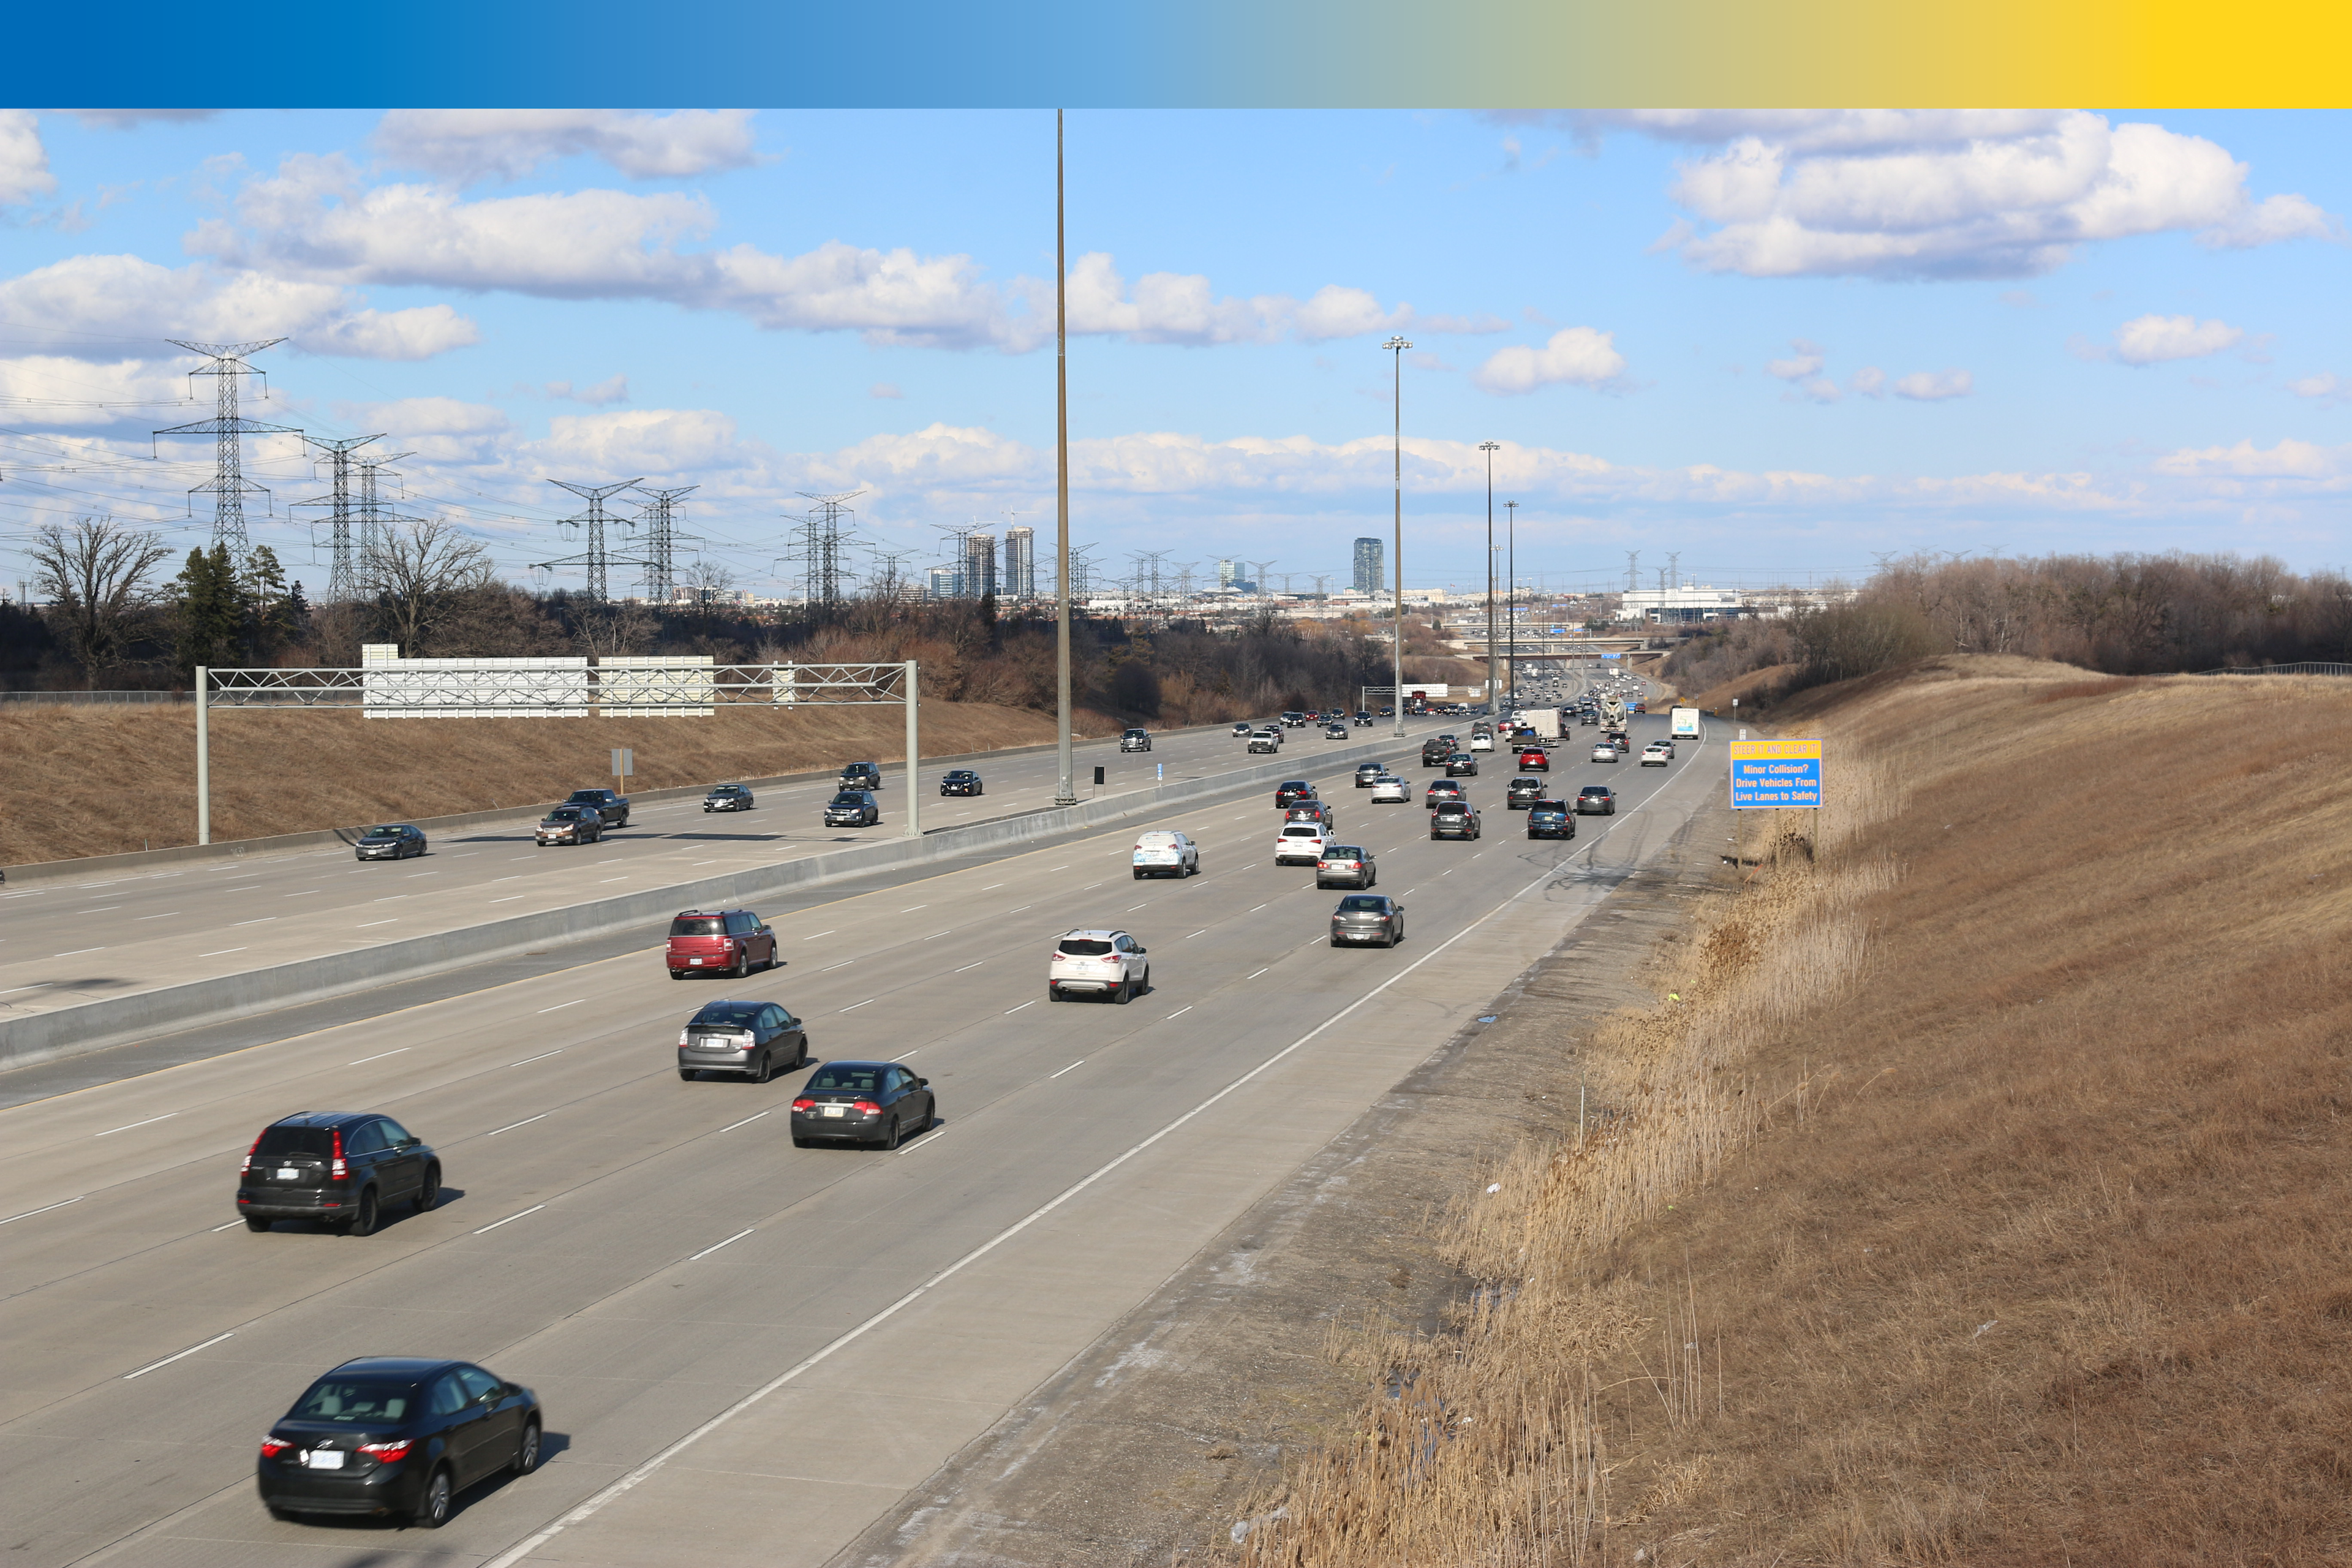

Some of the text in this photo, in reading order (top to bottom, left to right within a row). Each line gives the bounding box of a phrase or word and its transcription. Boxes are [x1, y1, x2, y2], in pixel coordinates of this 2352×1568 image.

[1734, 745, 1755, 755] STEER
[1758, 745, 1764, 754] IT
[1767, 745, 1781, 754] AND
[1784, 744, 1807, 753] CLEAR
[1744, 764, 1809, 774] Minor Collision?
[1736, 778, 1817, 787] Drive Vehicles From
[1736, 792, 1752, 801] Live
[1755, 791, 1779, 801] Lanes
[1792, 791, 1817, 802] Safety
